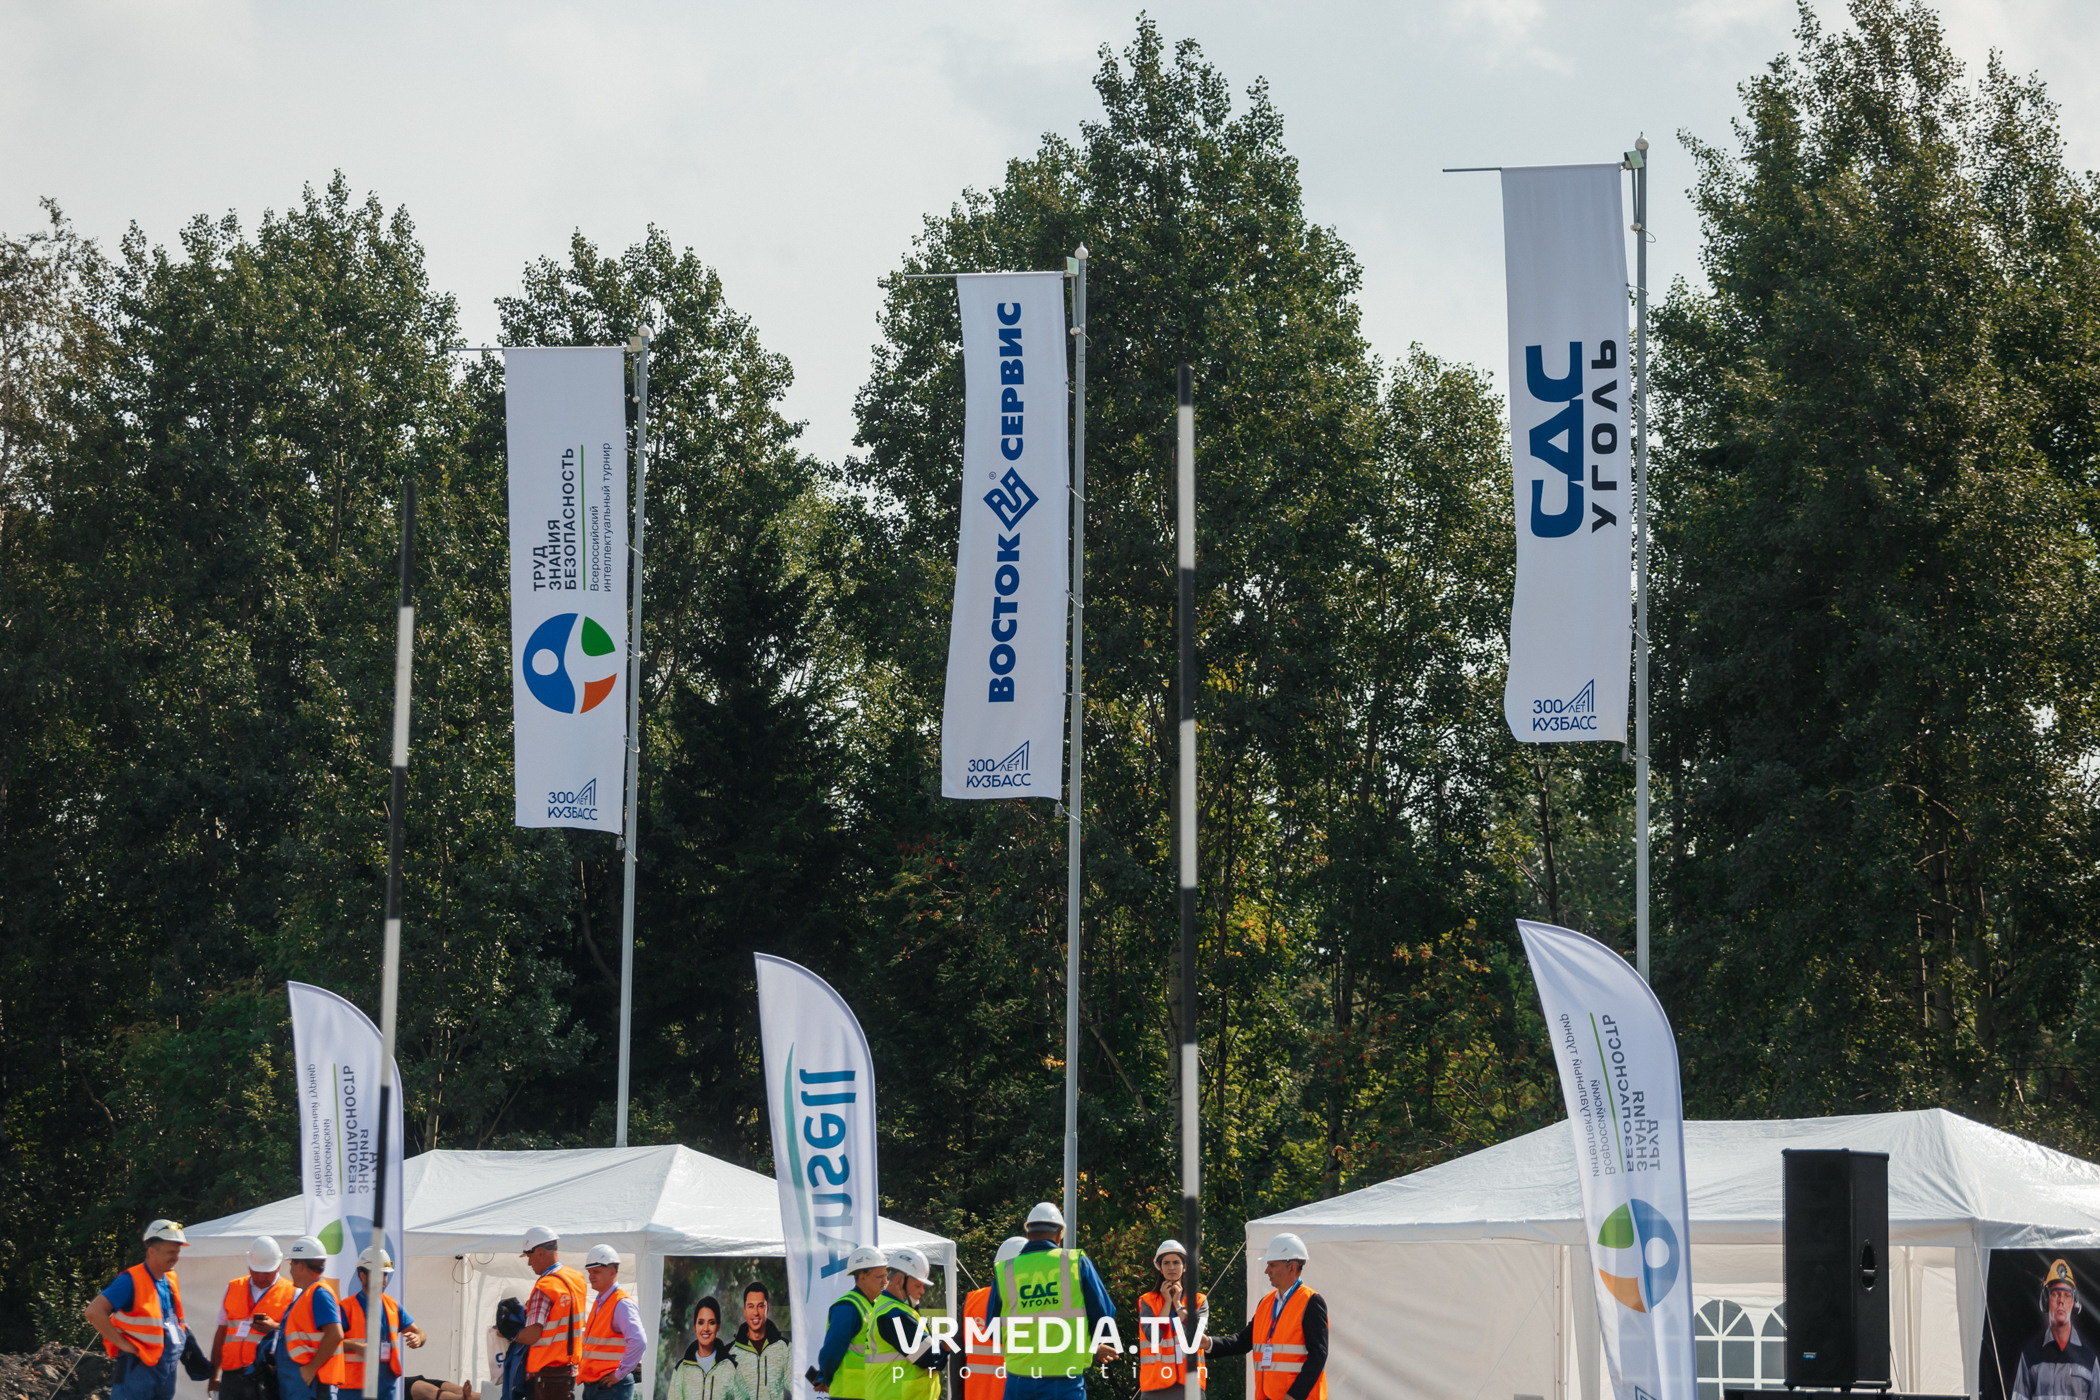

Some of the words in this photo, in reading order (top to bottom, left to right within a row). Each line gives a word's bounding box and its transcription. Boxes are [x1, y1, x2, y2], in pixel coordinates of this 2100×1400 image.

[997, 302, 1024, 461] СЕРВИС
[1591, 339, 1618, 533] УГОЛЬ
[602, 442, 613, 482] турнир
[561, 448, 577, 590] БЕЗОПАСНОСТЬ
[601, 484, 614, 593] интеллектуальный
[533, 545, 548, 592] ТРУД
[547, 519, 562, 591] ЗНАНИЯ
[589, 505, 602, 592] Всероссийский
[988, 532, 1021, 702] ВОСТОК
[1532, 698, 1563, 714] 300
[1532, 715, 1597, 731] КУЗБАСС
[966, 772, 1031, 788] КУЗБАСС
[967, 758, 995, 773] 300
[547, 806, 598, 821] КУЗБАСС
[548, 791, 575, 804] 300
[1020, 1297, 1059, 1309] УГОЛЬ
